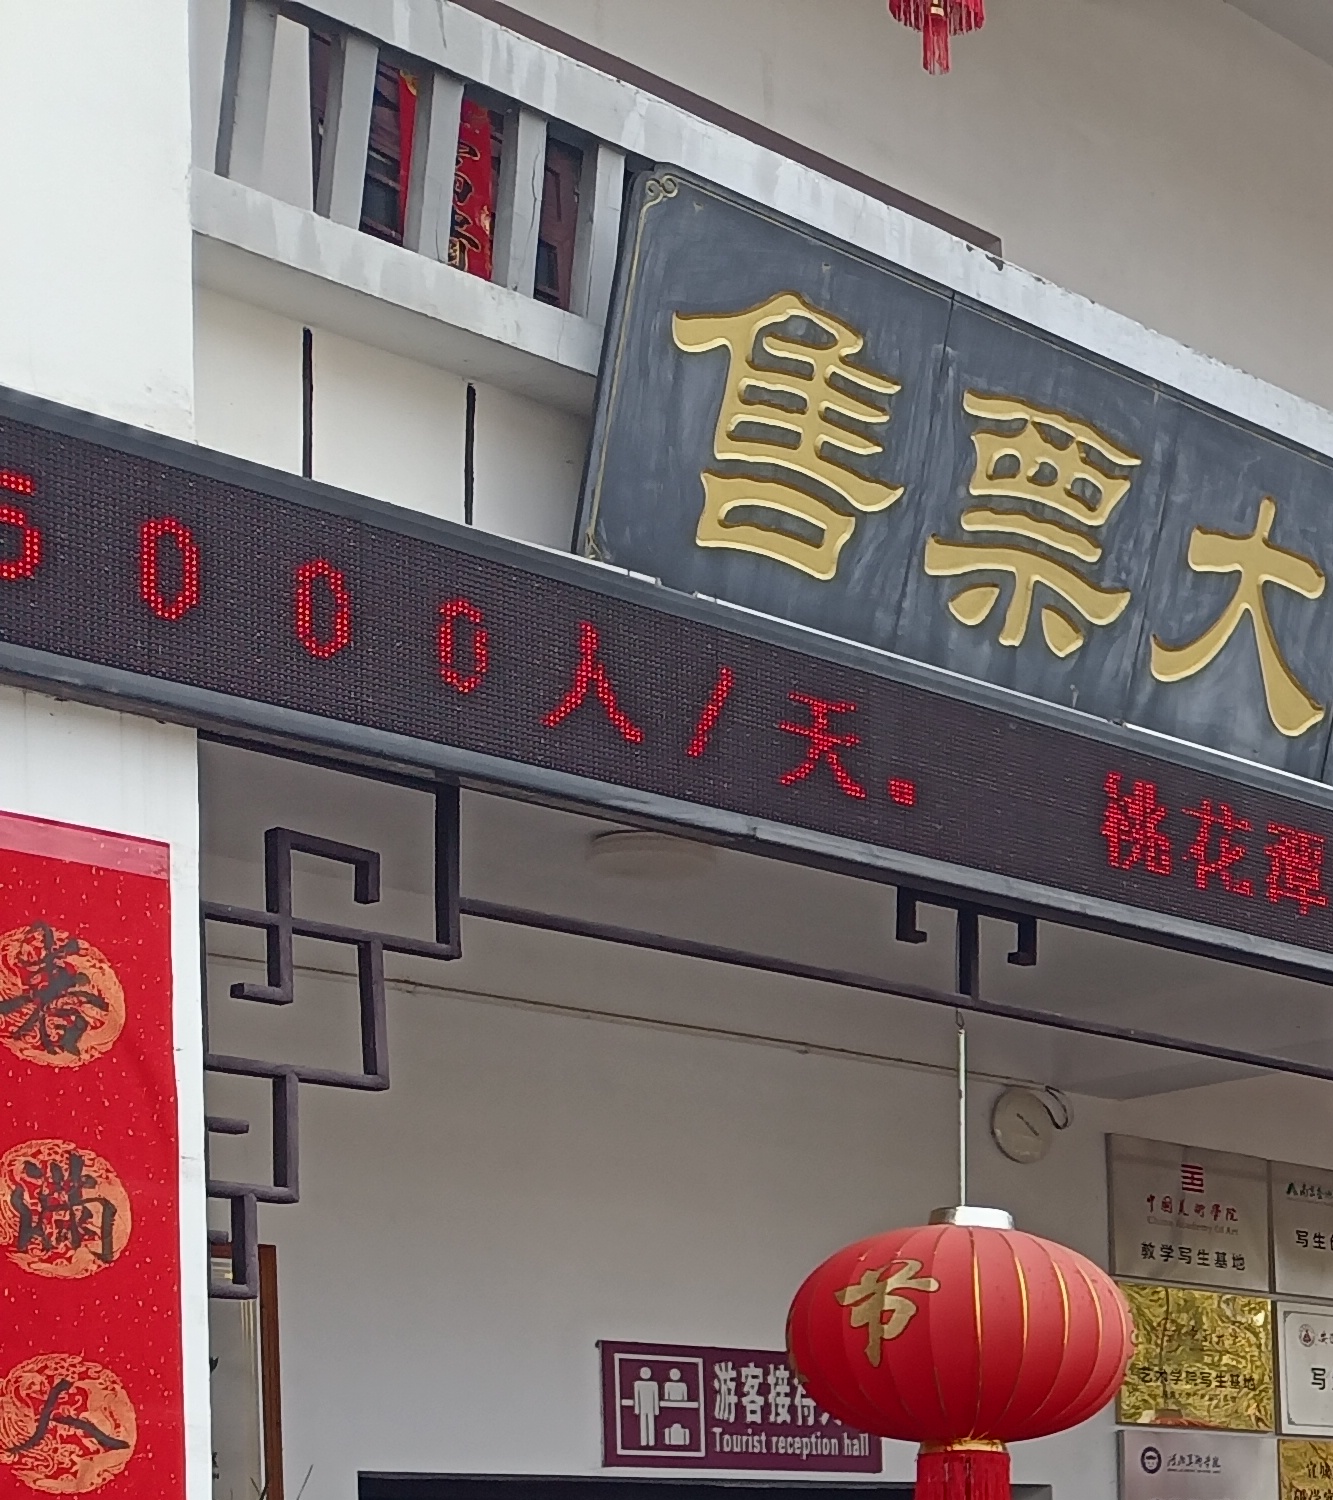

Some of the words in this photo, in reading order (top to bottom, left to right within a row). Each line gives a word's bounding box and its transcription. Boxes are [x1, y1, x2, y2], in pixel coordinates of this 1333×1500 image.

[1141, 1242, 1246, 1271] 教学写生基地
[834, 1258, 941, 1368] 节
[713, 1361, 843, 1427] 游客接待
[1138, 1366, 1256, 1391] 艺术学院写生基地
[711, 1427, 767, 1454] Tourist
[771, 1430, 839, 1460] reception
[843, 1432, 870, 1456] hall
